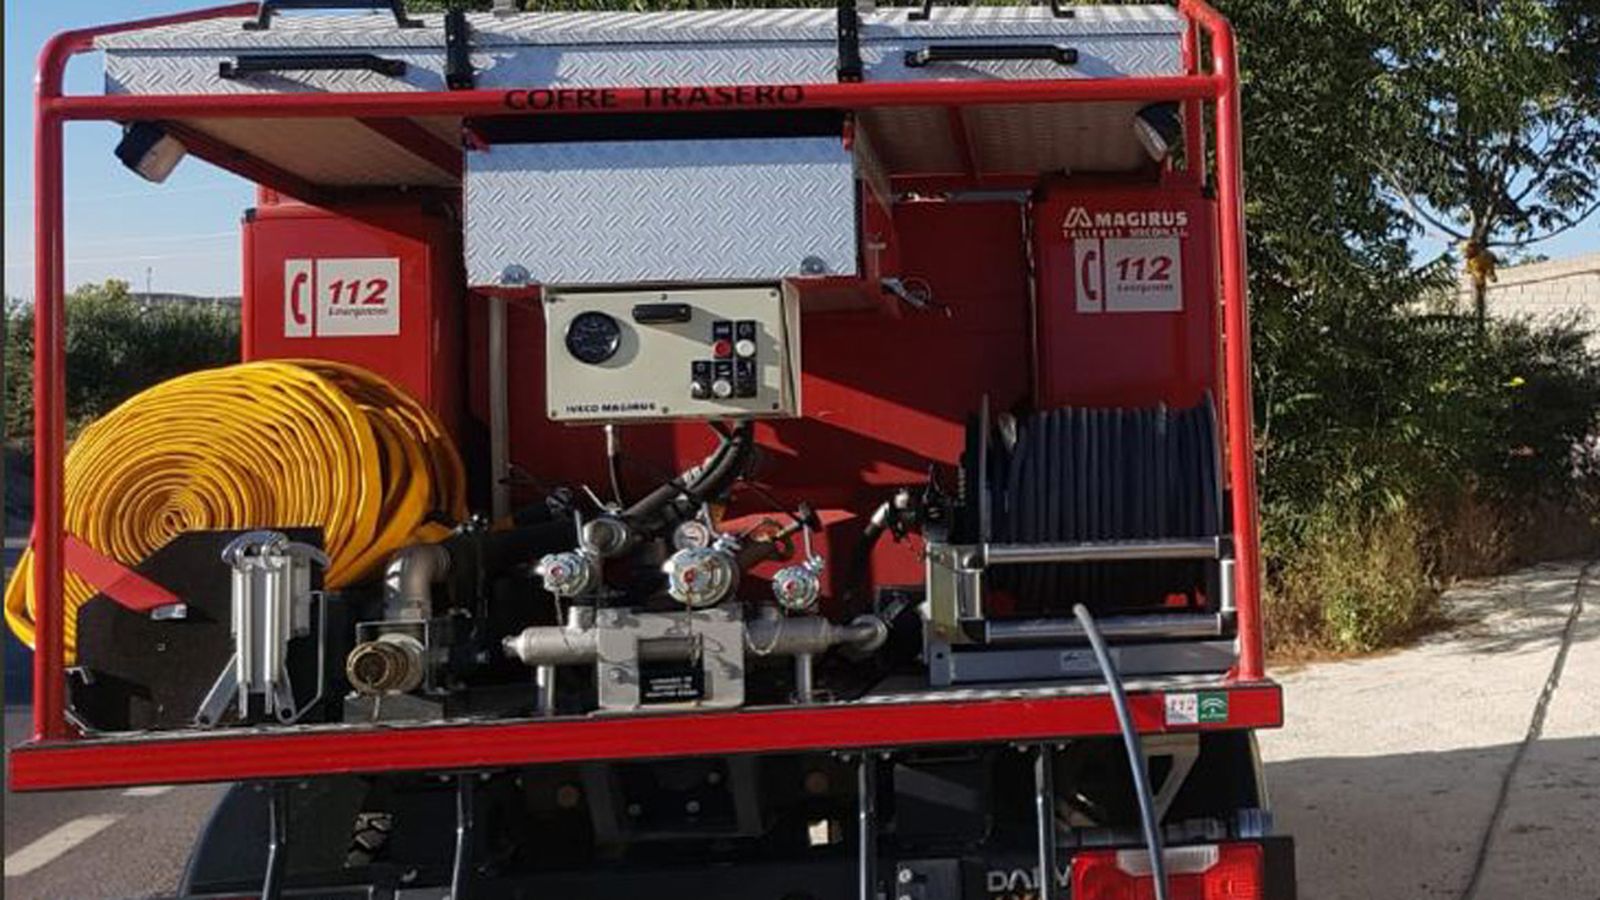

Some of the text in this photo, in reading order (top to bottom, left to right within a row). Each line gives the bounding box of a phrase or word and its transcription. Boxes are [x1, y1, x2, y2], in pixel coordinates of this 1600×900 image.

[504, 84, 805, 110] COFRE TRASERO
[1095, 211, 1188, 227] MAGIRUS
[1117, 256, 1172, 281] 112
[328, 279, 389, 305] 112
[566, 402, 655, 413] IVECO MAGIRUS
